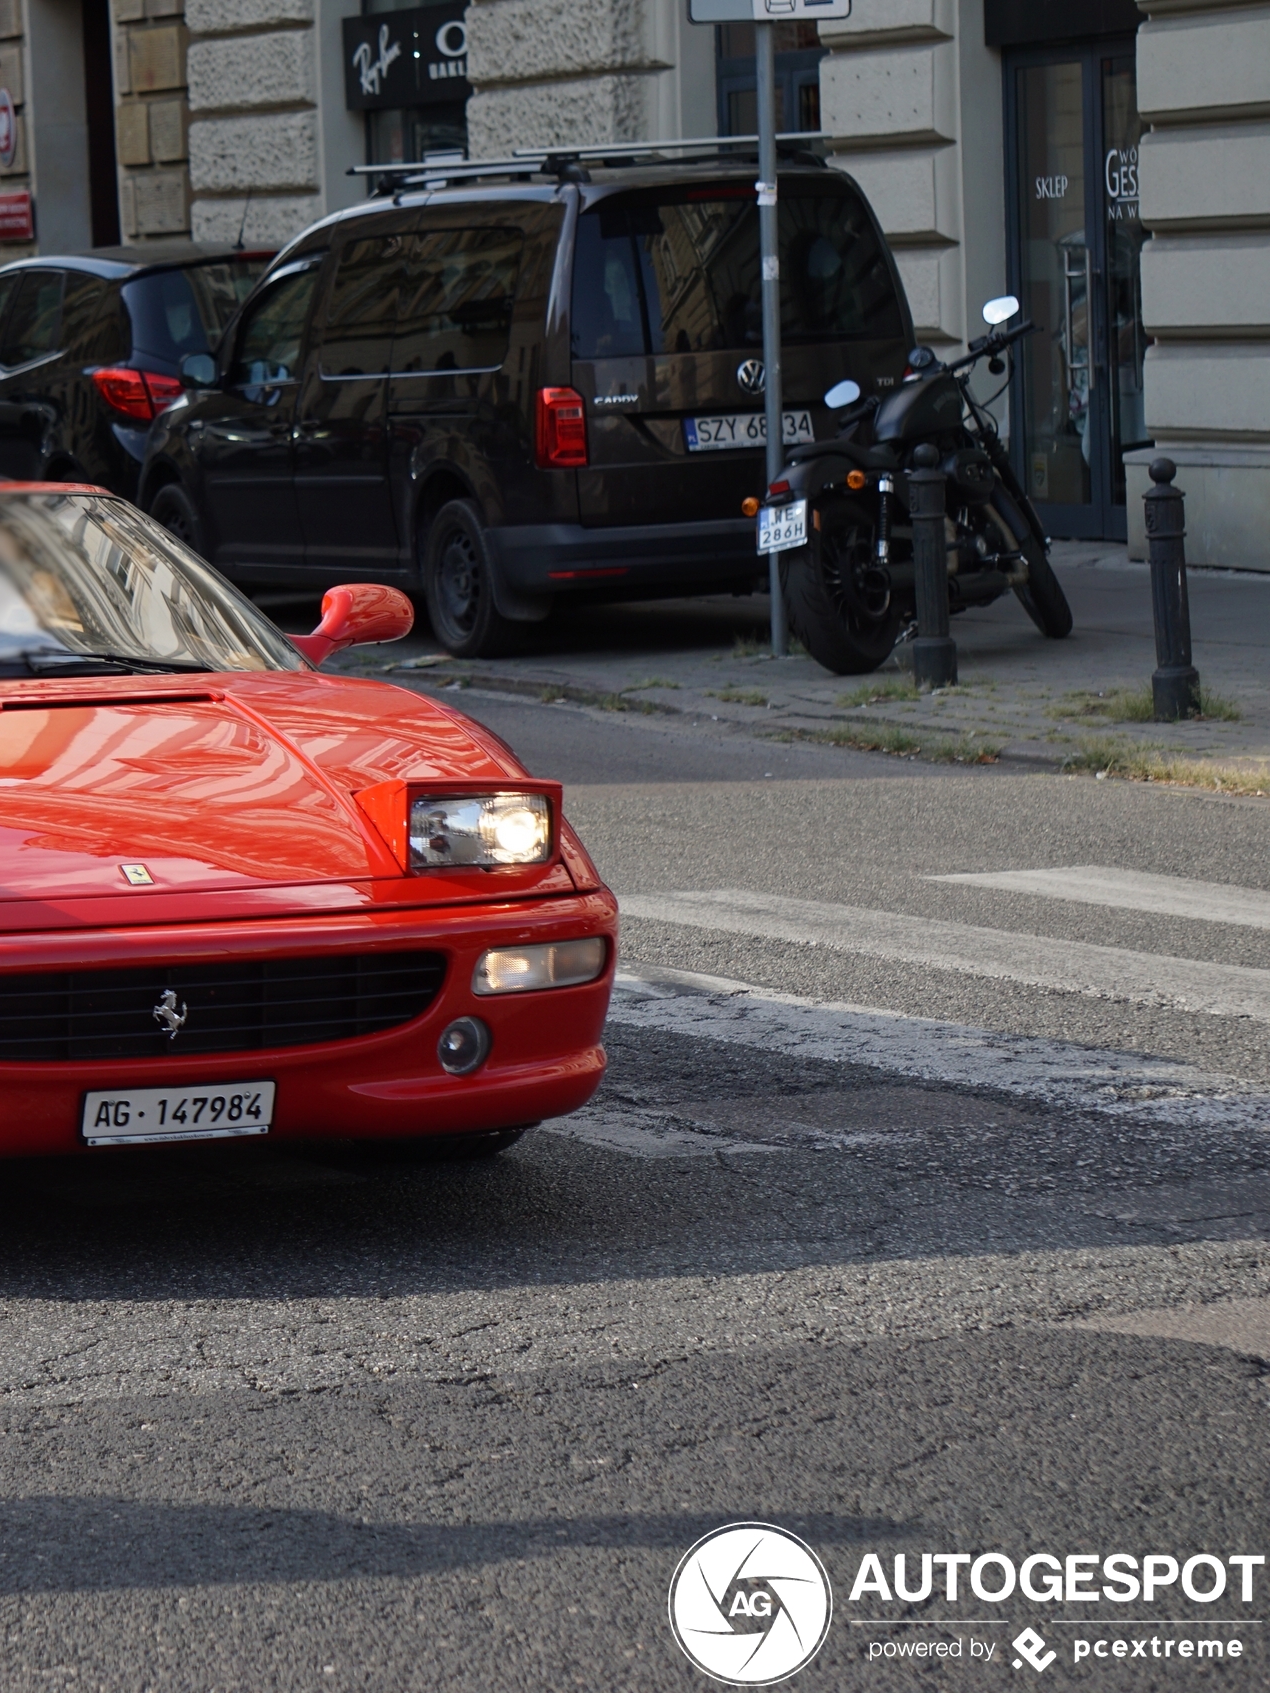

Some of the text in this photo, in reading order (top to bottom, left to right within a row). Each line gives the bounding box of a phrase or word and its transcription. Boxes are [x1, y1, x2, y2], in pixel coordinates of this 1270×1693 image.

[429, 60, 467, 80] OAKL
[1119, 145, 1138, 163] WÓ
[1105, 149, 1139, 198] GES
[1035, 175, 1068, 199] SKLEP
[1108, 204, 1137, 219] NA W
[877, 377, 894, 387] TDI
[698, 412, 810, 442] SZY 6834
[774, 508, 796, 524] WE
[762, 522, 803, 545] 286H
[94, 1093, 262, 1127] AG 147984
